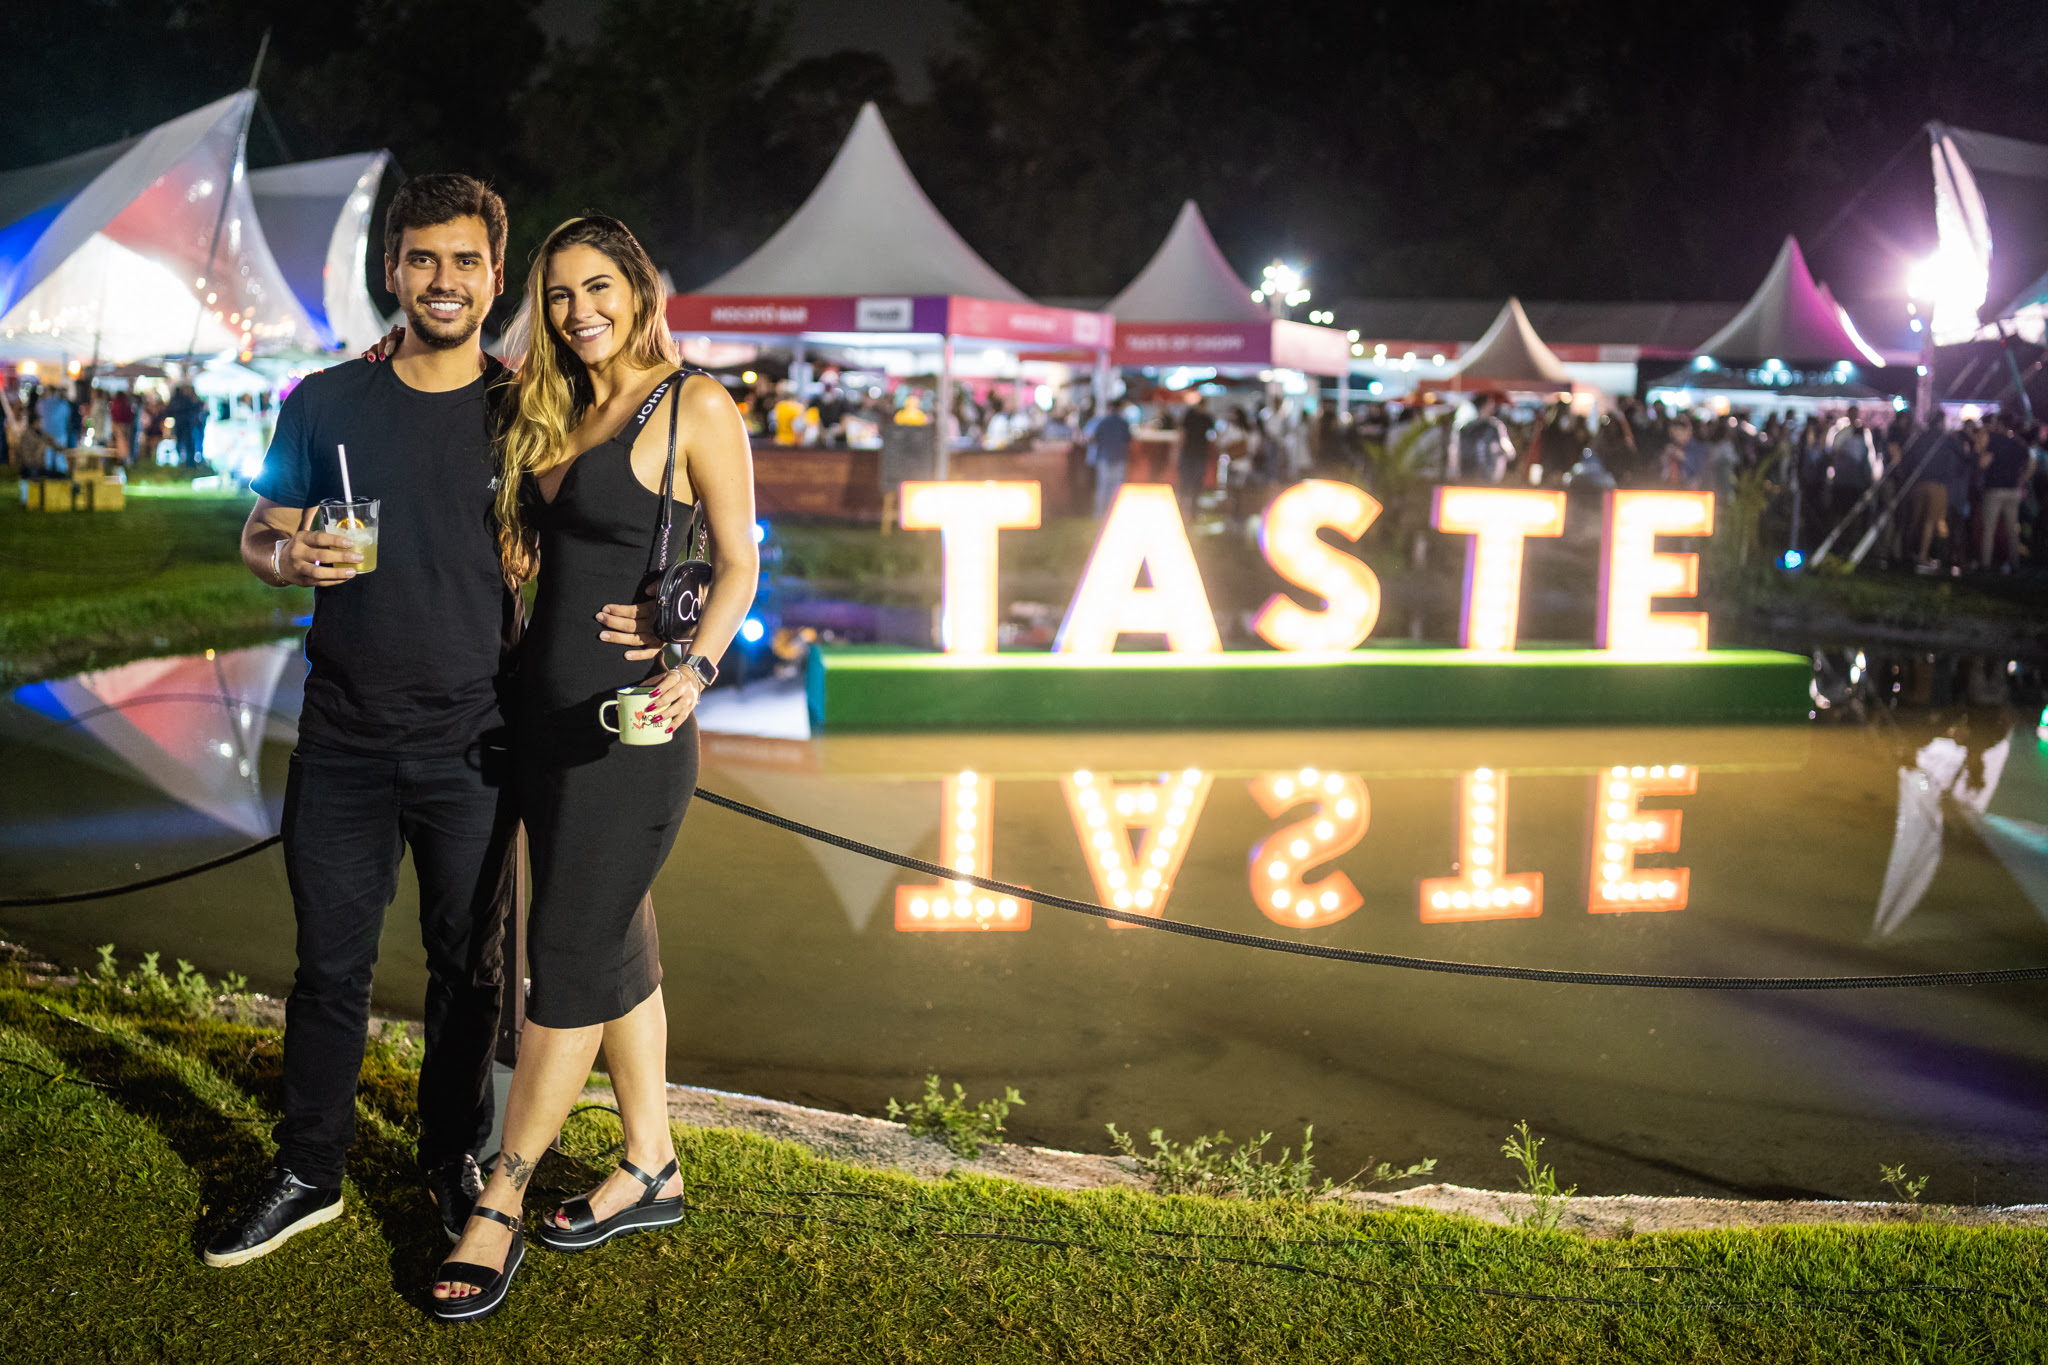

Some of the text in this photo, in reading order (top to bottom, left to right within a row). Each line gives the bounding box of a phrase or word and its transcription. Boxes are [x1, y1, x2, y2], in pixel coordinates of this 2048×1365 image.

[777, 307, 807, 322] BAR
[637, 383, 669, 424] JOHN
[900, 480, 1716, 653] TASTE
